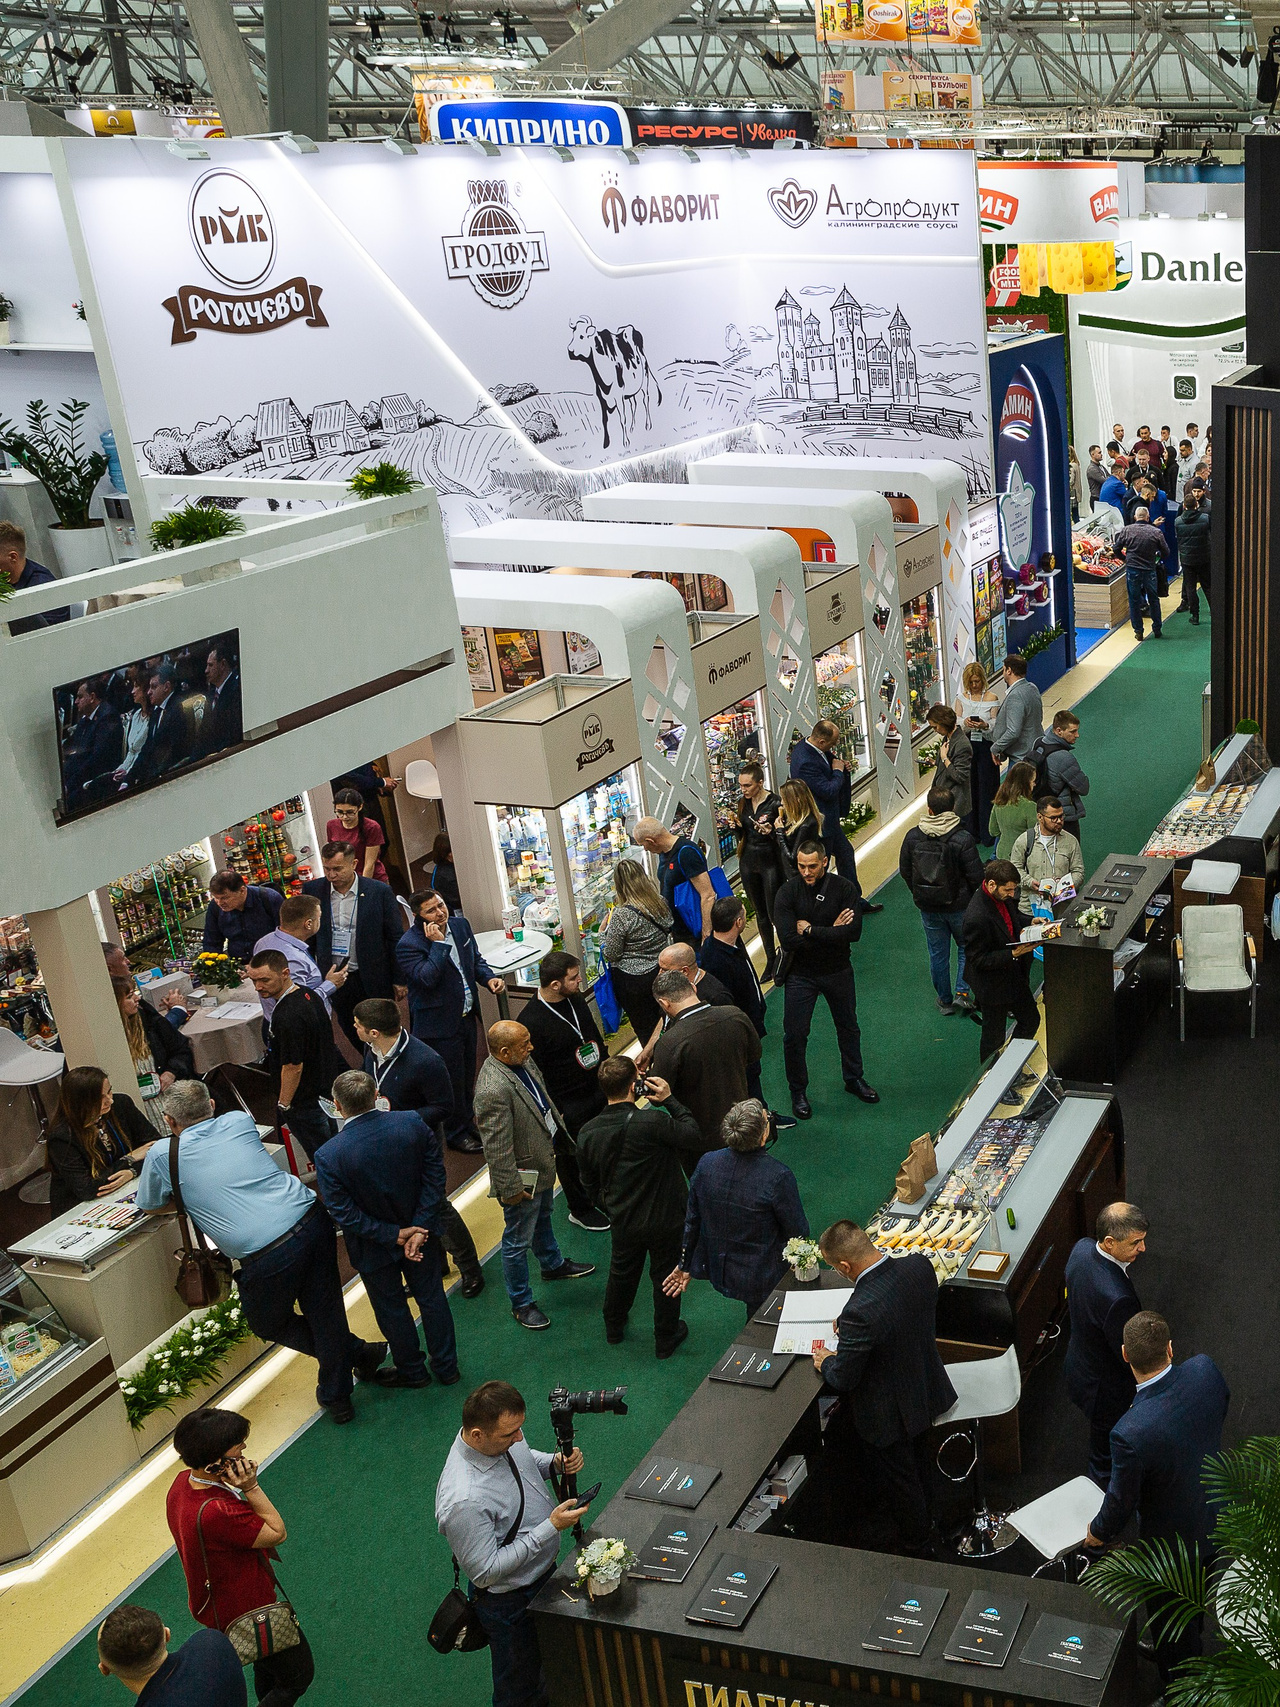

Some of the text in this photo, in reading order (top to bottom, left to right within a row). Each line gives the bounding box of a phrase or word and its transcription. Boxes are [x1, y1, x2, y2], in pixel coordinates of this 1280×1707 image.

[451, 117, 611, 147] КИПРИНО
[637, 125, 739, 140] РЕСУРС
[631, 193, 720, 226] ФАВОРИТ
[827, 221, 959, 230] калининградские соусы
[448, 240, 545, 271] ГРОДФУД
[718, 651, 752, 678] ФАВОРИТ
